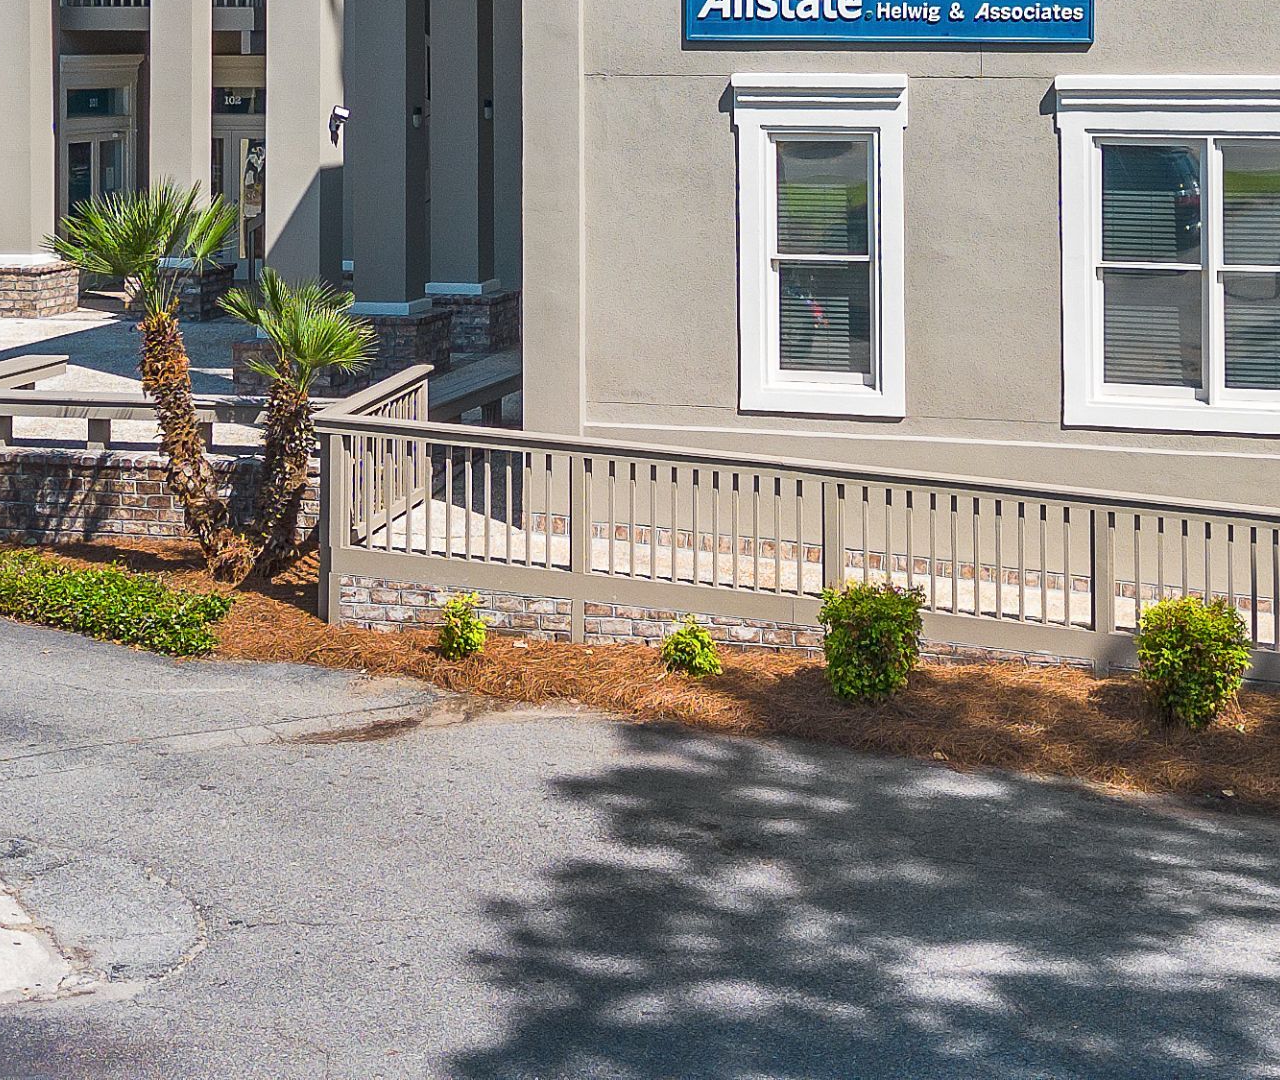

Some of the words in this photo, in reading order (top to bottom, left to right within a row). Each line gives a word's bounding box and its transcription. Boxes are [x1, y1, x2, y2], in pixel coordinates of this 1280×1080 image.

[876, 2, 942, 23] Helwig
[949, 2, 965, 20] &
[974, 2, 1084, 21] Associates
[224, 95, 242, 105] 102
